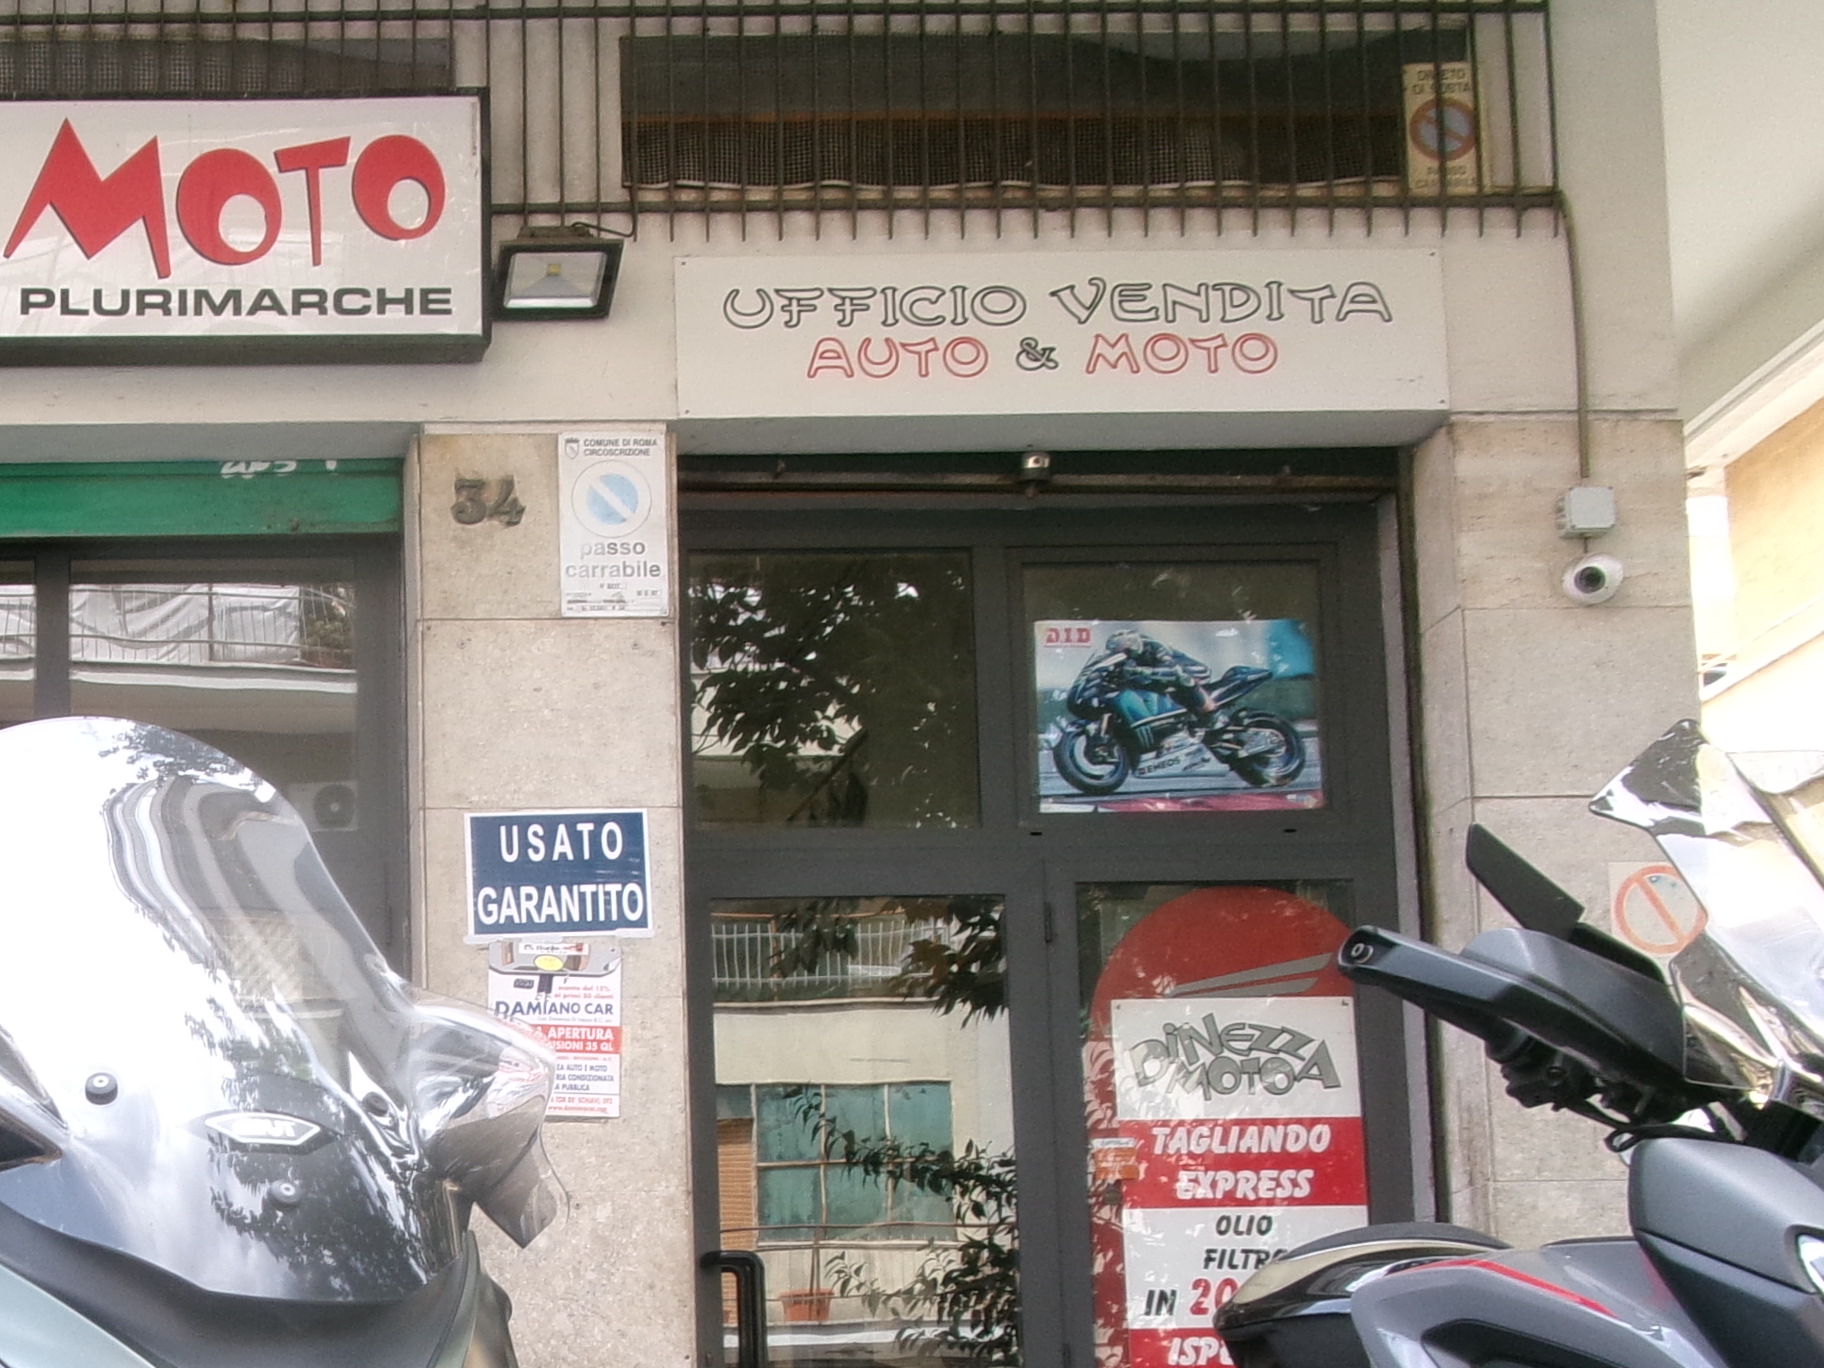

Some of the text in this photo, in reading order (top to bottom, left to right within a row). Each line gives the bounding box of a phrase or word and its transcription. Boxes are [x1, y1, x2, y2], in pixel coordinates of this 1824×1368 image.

[3, 117, 445, 279] MOTO
[20, 287, 453, 316] PLURIMARCHE
[723, 276, 1394, 329] UFFICIO VENDITA
[806, 331, 1278, 379] AUTO & MOTO
[583, 438, 658, 447] COMUNE DI ROMA
[583, 448, 651, 457] CIRCOSCRIZIONE
[580, 541, 646, 559] passo
[565, 561, 661, 578] carrabile
[499, 821, 623, 863] USATO
[477, 882, 644, 925] GARANTITO
[495, 1001, 613, 1017] DAMIANO CAR
[548, 1026, 614, 1040] APERTURA
[1166, 1056, 1294, 1101] MOTO
[1152, 1124, 1331, 1155] TAGLIANDO
[1176, 1169, 1315, 1200] EXPRESS
[1216, 1215, 1273, 1236] OLIO
[1143, 1289, 1177, 1316] IN
